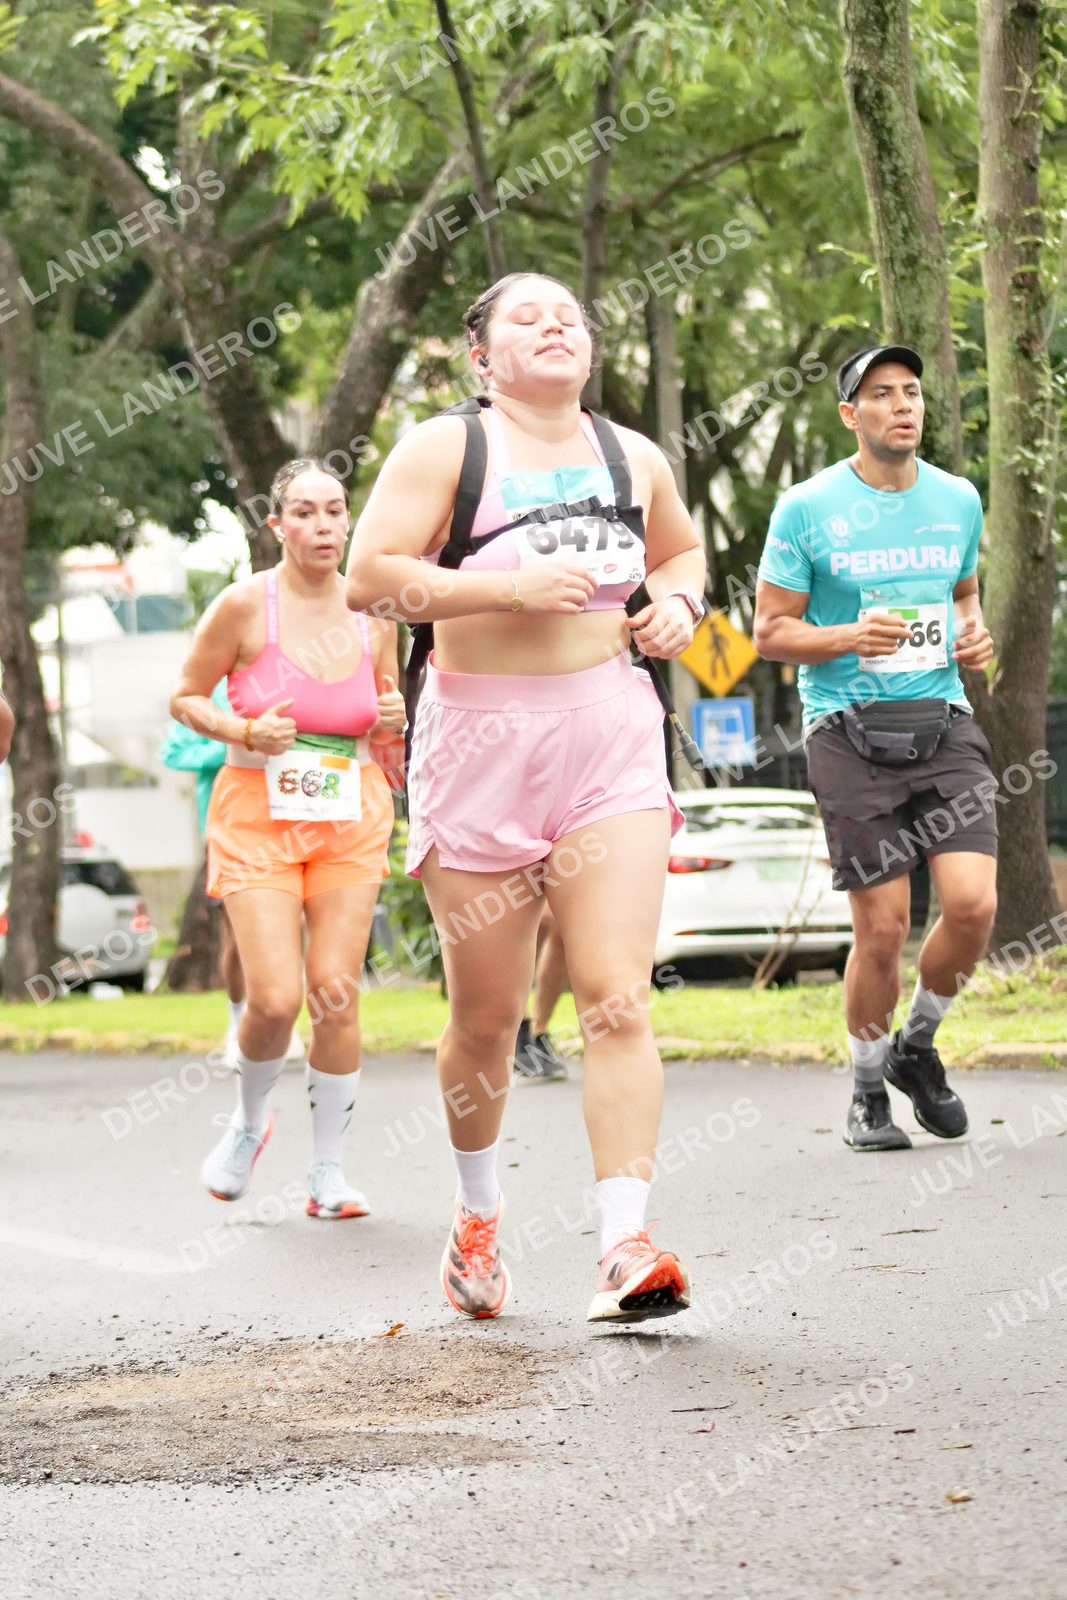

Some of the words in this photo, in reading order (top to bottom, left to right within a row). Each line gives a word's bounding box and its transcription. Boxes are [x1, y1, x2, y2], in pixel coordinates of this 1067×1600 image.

[526, 515, 634, 555] 6479
[830, 545, 960, 576] PERDURA
[278, 768, 340, 799] 668
